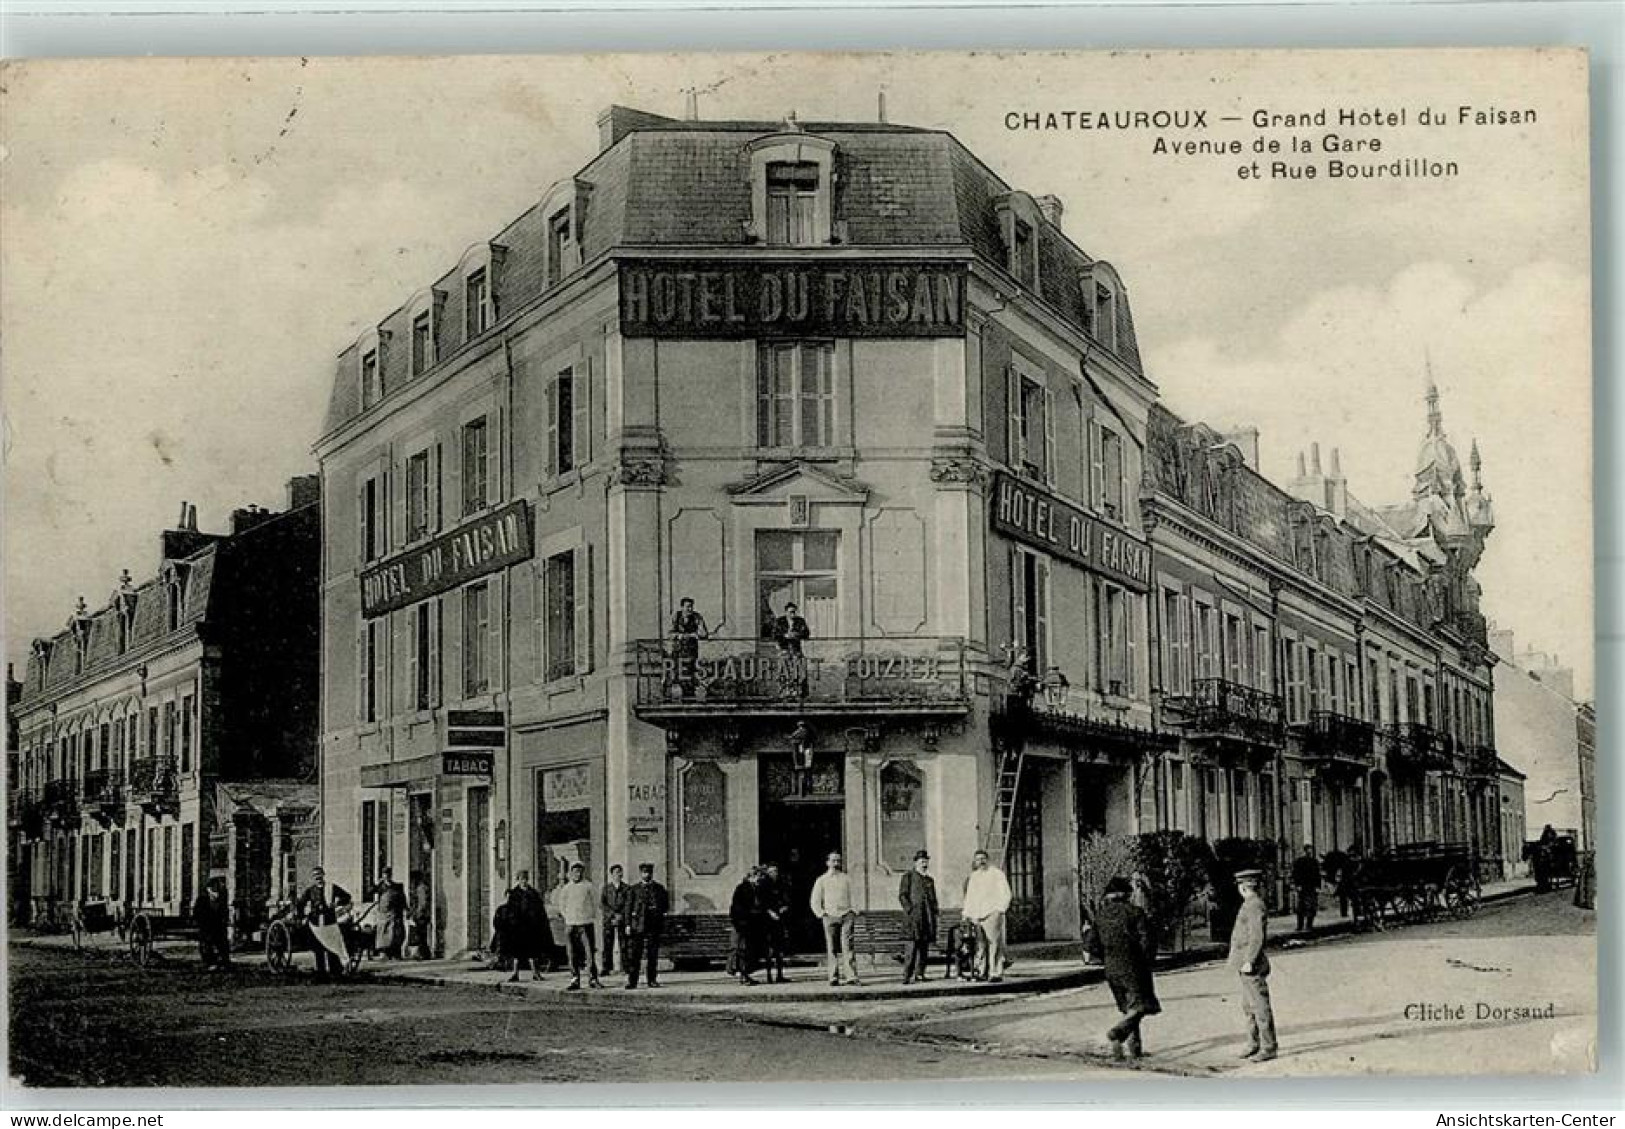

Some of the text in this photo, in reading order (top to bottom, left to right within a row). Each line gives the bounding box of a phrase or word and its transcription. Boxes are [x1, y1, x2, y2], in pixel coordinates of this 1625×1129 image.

[1004, 111, 1208, 132] CHATEAUROUX
[1252, 109, 1326, 129] Grand
[1418, 108, 1446, 127] du
[1459, 106, 1537, 127] Faisan
[1152, 134, 1381, 157] Avenue de la Gare
[1237, 159, 1458, 181] et Rue Bourdillon
[626, 271, 960, 327] HOTEL DU FAISAN
[1001, 481, 1150, 584] HOTEL DU FAISAN
[364, 513, 519, 609] HOTEL DU FAISAN
[661, 656, 824, 681] RESTAURANT
[446, 758, 489, 774] TABAC
[628, 784, 665, 802] TABAC
[1403, 1002, 1466, 1022] Cliché
